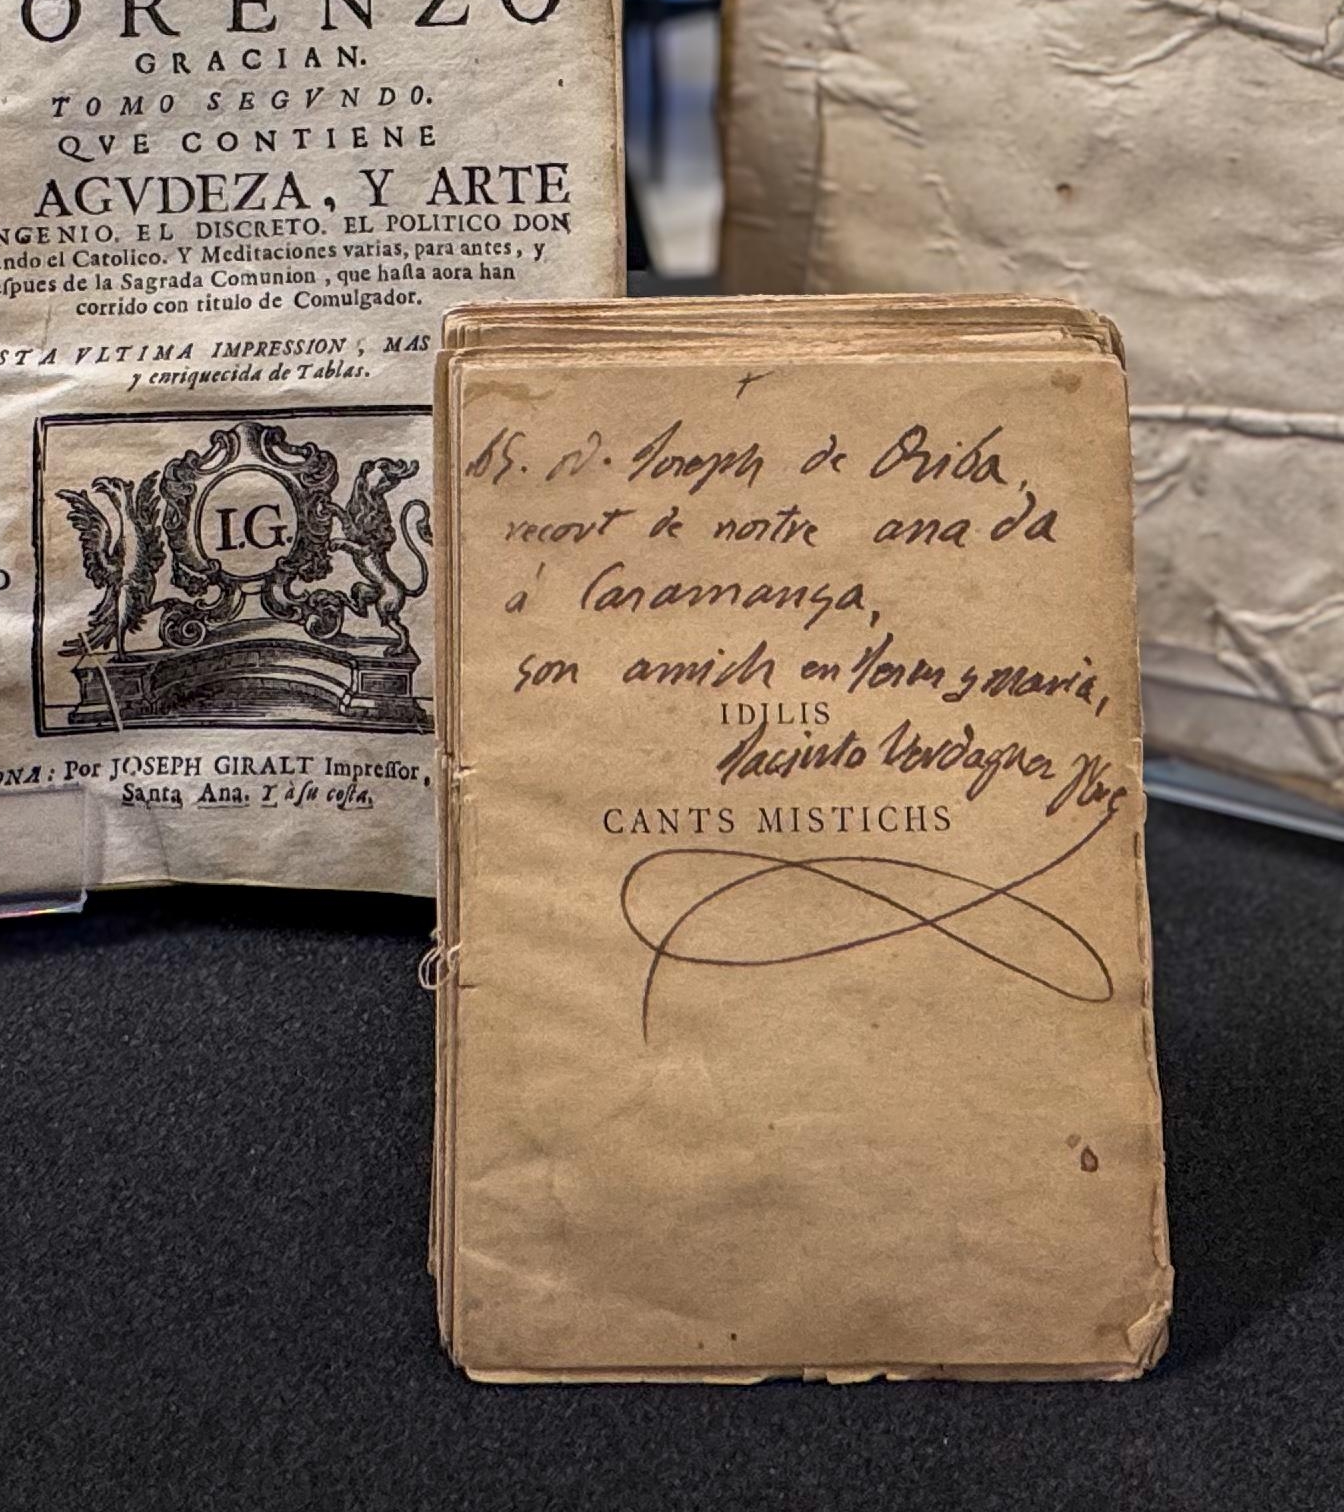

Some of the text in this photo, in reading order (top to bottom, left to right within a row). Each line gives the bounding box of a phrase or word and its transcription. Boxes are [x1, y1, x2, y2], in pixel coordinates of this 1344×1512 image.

[135, 45, 367, 75] GRACIAN.
[51, 92, 175, 120] TOMO
[58, 124, 438, 163] QVE CONTIENE
[359, 167, 395, 208] Y
[426, 162, 572, 206] ARTE
[137, 223, 175, 242] EL
[196, 216, 328, 240] DISCRETO.
[344, 215, 374, 235] EL
[386, 213, 502, 234] POLITICO
[513, 211, 572, 235] DON
[46, 250, 65, 269] el
[72, 247, 168, 269] Catolico.
[176, 246, 193, 265] Y
[201, 241, 337, 265] Meditaciones
[343, 240, 410, 260] varias,
[414, 241, 455, 264] para
[533, 241, 546, 262] y
[62, 273, 89, 293] de
[94, 272, 113, 291] la
[120, 271, 204, 295] Sagrada
[336, 264, 372, 287] que
[431, 265, 473, 282] aora
[479, 262, 516, 281] han
[75, 287, 423, 317] corrido con titulo de Comulgador.
[74, 342, 195, 365] VLTIMA
[382, 334, 431, 355] MAS
[128, 357, 371, 392] y enriquecida de Tablas.
[799, 433, 848, 476] de
[649, 504, 685, 541] de
[801, 657, 841, 683] en
[719, 701, 831, 726] IDILIS
[63, 759, 102, 781] Por
[109, 755, 202, 781] JOSEPH
[213, 753, 315, 778] GIRALT
[121, 782, 184, 807] Santa
[196, 782, 251, 806] Ana.
[602, 803, 953, 836] CANTS MISTICHS
